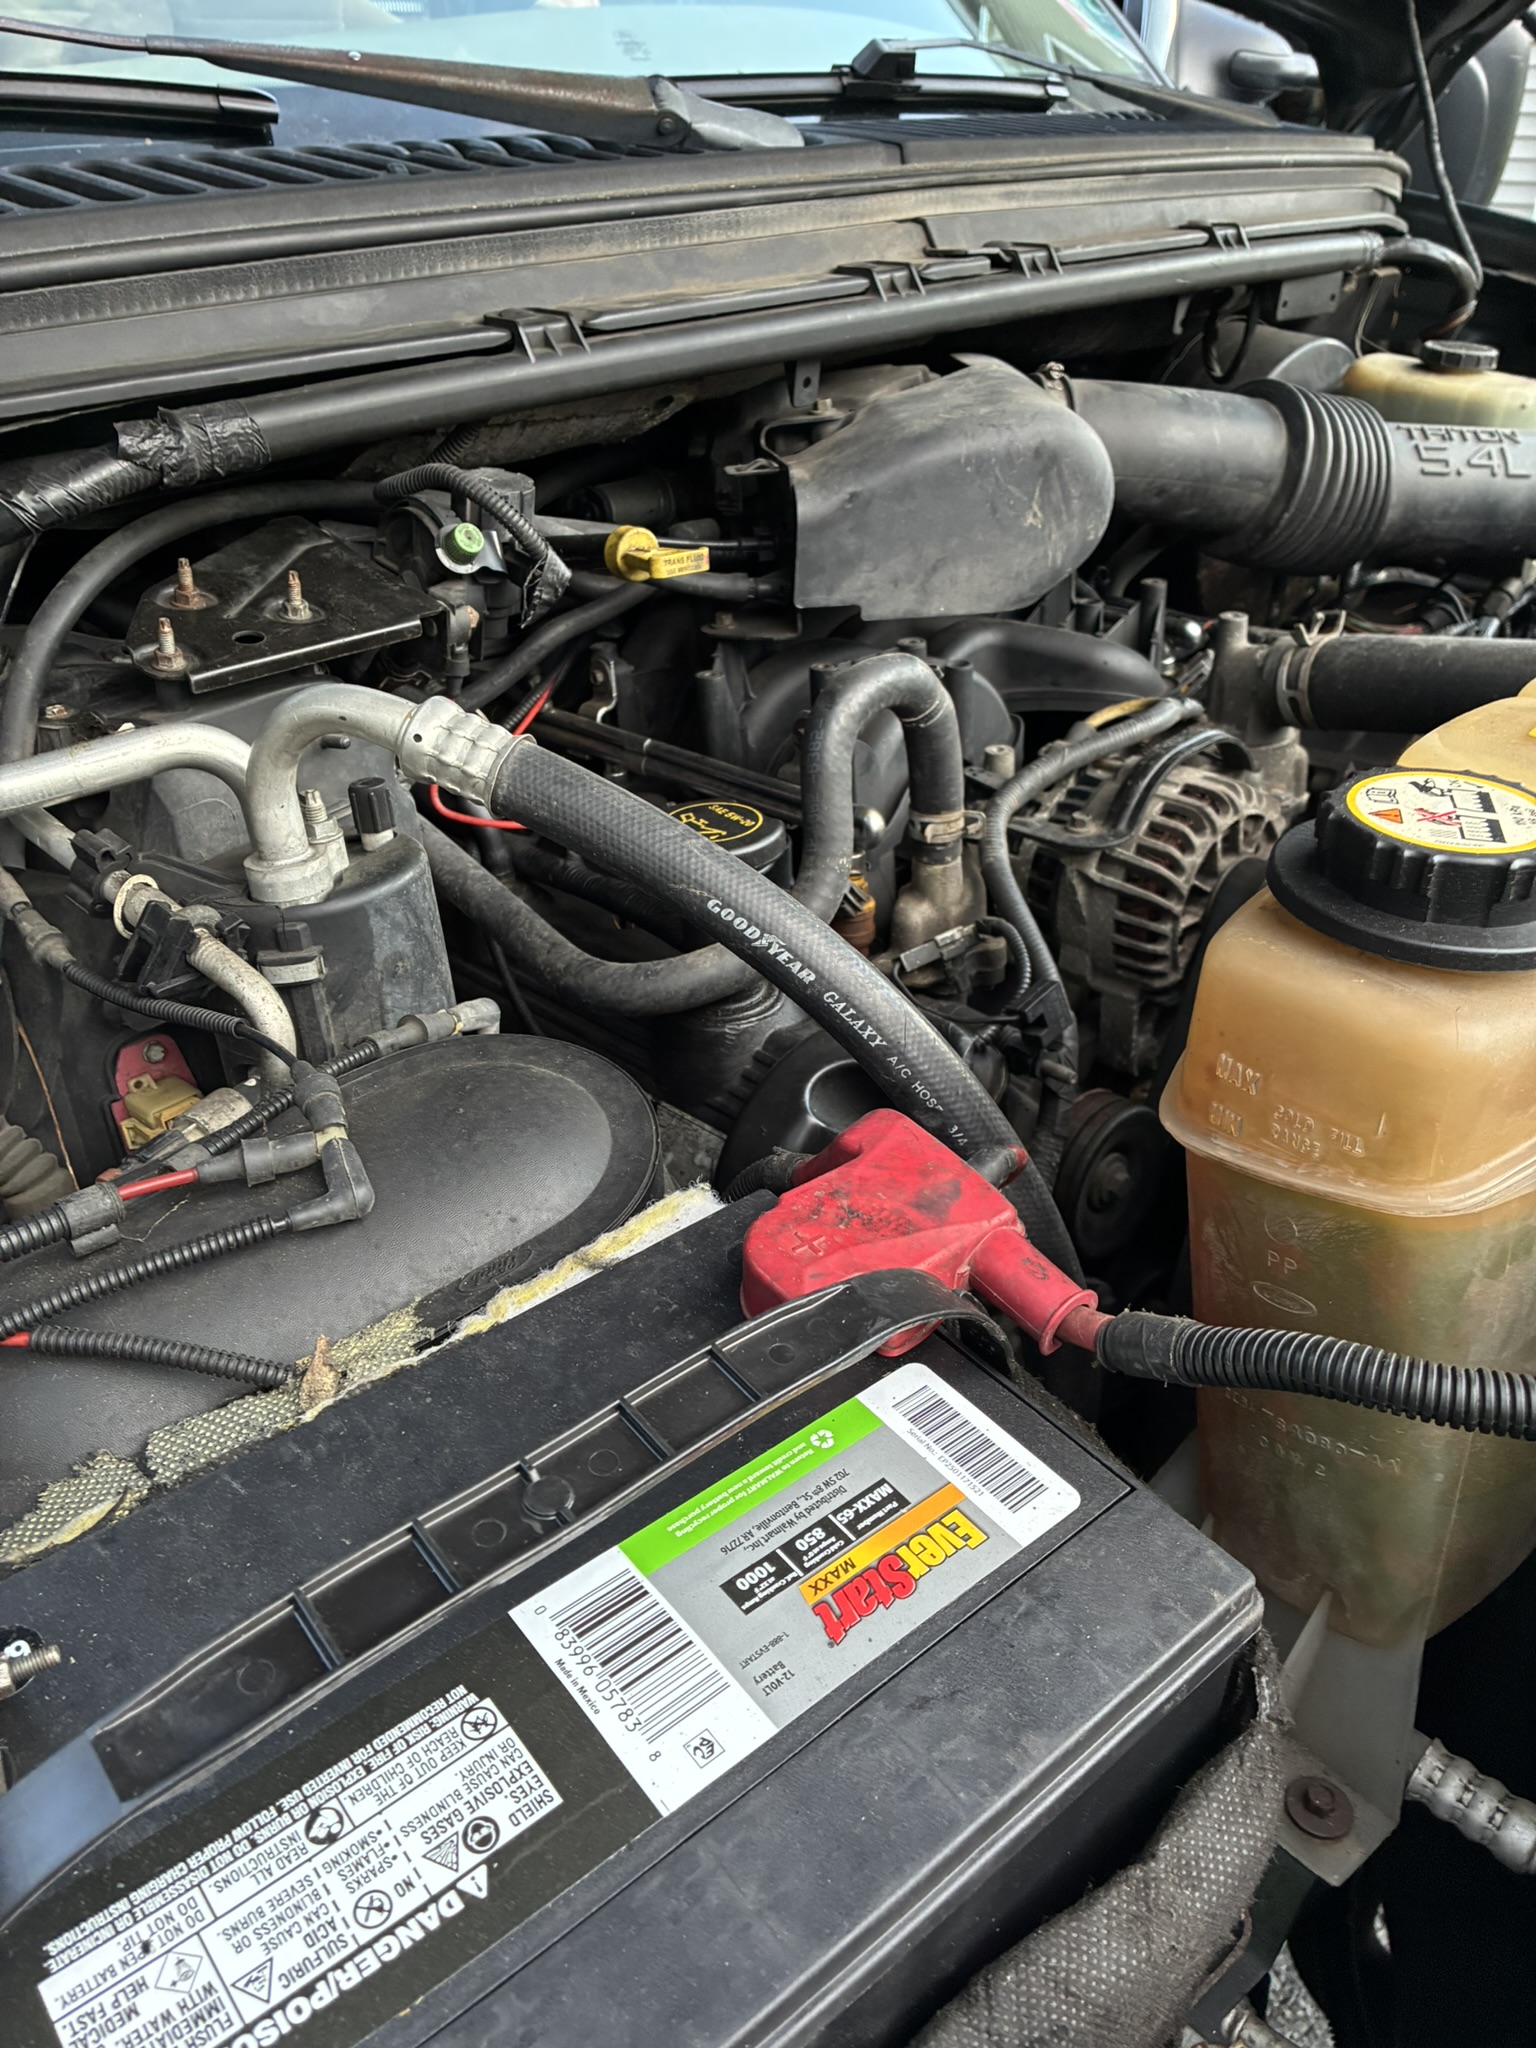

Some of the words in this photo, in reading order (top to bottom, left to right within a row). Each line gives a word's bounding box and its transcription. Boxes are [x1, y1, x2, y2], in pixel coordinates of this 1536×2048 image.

[1396, 427, 1521, 444] TRITON
[1413, 443, 1531, 479] 5.4L
[708, 804, 729, 815] SAE
[724, 811, 756, 827] 5W-20
[706, 899, 817, 984] GOODYEAR
[823, 991, 888, 1048] GALAXY
[887, 1056, 912, 1079] A/C
[790, 1441, 808, 1453] and
[905, 1427, 926, 1445] Serial
[770, 1450, 794, 1466] credit
[779, 1462, 791, 1471] to
[788, 1447, 815, 1466] Return
[744, 1467, 783, 1494] WALMART
[746, 1462, 774, 1482] toward
[820, 1476, 837, 1489] SW
[832, 1467, 850, 1481] 702
[726, 1481, 743, 1493] new
[733, 1490, 748, 1501] for
[794, 1490, 814, 1505] St.,
[803, 1484, 847, 1516] Distributed
[808, 1484, 825, 1497] 8th
[698, 1489, 729, 1512] battery
[706, 1496, 736, 1517] proper
[833, 1482, 894, 1525] MAXX-65
[880, 1500, 899, 1513] Part
[664, 1507, 702, 1533] purchase
[673, 1512, 711, 1539] recycling
[750, 1499, 801, 1534] Bentonville,
[790, 1509, 807, 1523] by
[855, 1509, 884, 1531] Number
[737, 1528, 755, 1543] AR
[760, 1516, 798, 1544] Walmart
[792, 1526, 828, 1552] 850
[818, 1534, 837, 1549] Amps
[718, 1536, 744, 1555] 72716
[742, 1537, 765, 1555] Inc.,
[801, 1547, 832, 1569] Cranking
[828, 1538, 845, 1552] Cold
[733, 1559, 777, 1592] 1000
[756, 1577, 787, 1600] Cranking
[804, 1507, 990, 1647] EverStart
[805, 1556, 859, 1596] MAXX
[739, 1594, 760, 1611] Amps
[737, 1630, 790, 1669] 1-888-EVSTART
[553, 1657, 575, 1680] Made
[750, 1658, 786, 1686] Battery
[442, 1683, 468, 1704] NOT
[534, 1605, 548, 1616] 0
[554, 1627, 596, 1677] 83996
[595, 1677, 644, 1734] 05783
[648, 1750, 662, 1762] 8
[569, 1677, 582, 1687] in
[760, 1668, 795, 1696] 12-VOLT
[426, 1691, 480, 1730] WARNING:
[575, 1685, 603, 1715] Mexico
[370, 1696, 448, 1751] RECOMMENDED
[403, 1721, 432, 1745] RISK
[348, 1742, 375, 1765] FOR
[388, 1737, 408, 1755] OF
[419, 1726, 460, 1757] REACH
[436, 1737, 467, 1762] KEEP
[496, 1736, 516, 1754] OR
[403, 1750, 422, 1768] OF
[412, 1755, 438, 1779] OUT
[453, 1747, 499, 1783] INJURY.
[497, 1746, 524, 1769] CAN
[299, 1756, 354, 1797] INVERTED
[305, 1764, 367, 1810] EXPLOSION
[342, 1761, 406, 1808] CHILDREN.
[394, 1772, 414, 1790] OF
[460, 1762, 501, 1795] CAUSE
[461, 1759, 535, 1815] EXPLOSIVE
[371, 1783, 398, 1806] THE
[502, 1773, 545, 1808] EYES.
[288, 1799, 310, 1821] OR
[397, 1788, 464, 1838] BLINDNESS
[506, 1787, 555, 1828] SHIELD
[228, 1803, 278, 1842] FOLLOW
[418, 1807, 465, 1845] GASES
[184, 1832, 233, 1870] PROPER
[206, 1848, 234, 1873] NOT
[229, 1837, 251, 1858] DO
[273, 1841, 309, 1871] READ
[206, 1828, 302, 1897] INSTRUCTIONS.
[248, 1863, 275, 1888] ALL
[127, 1859, 189, 1906] CHARGING
[130, 1863, 210, 1921] DISASSEMBLE
[264, 1872, 314, 1913] SEVERE
[392, 1875, 415, 1898] NO
[175, 1894, 199, 1917] DO
[183, 1907, 205, 1929] DO
[251, 1886, 322, 1941] BLINDNESS
[301, 1901, 330, 1927] CAN
[41, 1894, 131, 1960] INSTRUCTIONS.
[111, 1910, 134, 1933] OR
[145, 1909, 175, 1936] NOT
[154, 1920, 184, 1948] NOT
[215, 1904, 266, 1945] BURNS.
[301, 1915, 339, 1949] ACID
[41, 1920, 116, 1978] INCINERATE.
[115, 1929, 143, 1955] TIP.
[230, 1933, 252, 1955] OR
[258, 1919, 304, 1957] CAUSE
[276, 1931, 349, 1990] SULFURIC
[53, 1961, 118, 2012] BATTERY.
[107, 1974, 149, 2011] HELP
[174, 1977, 218, 2016] WITH
[60, 2000, 107, 2041] FAST.
